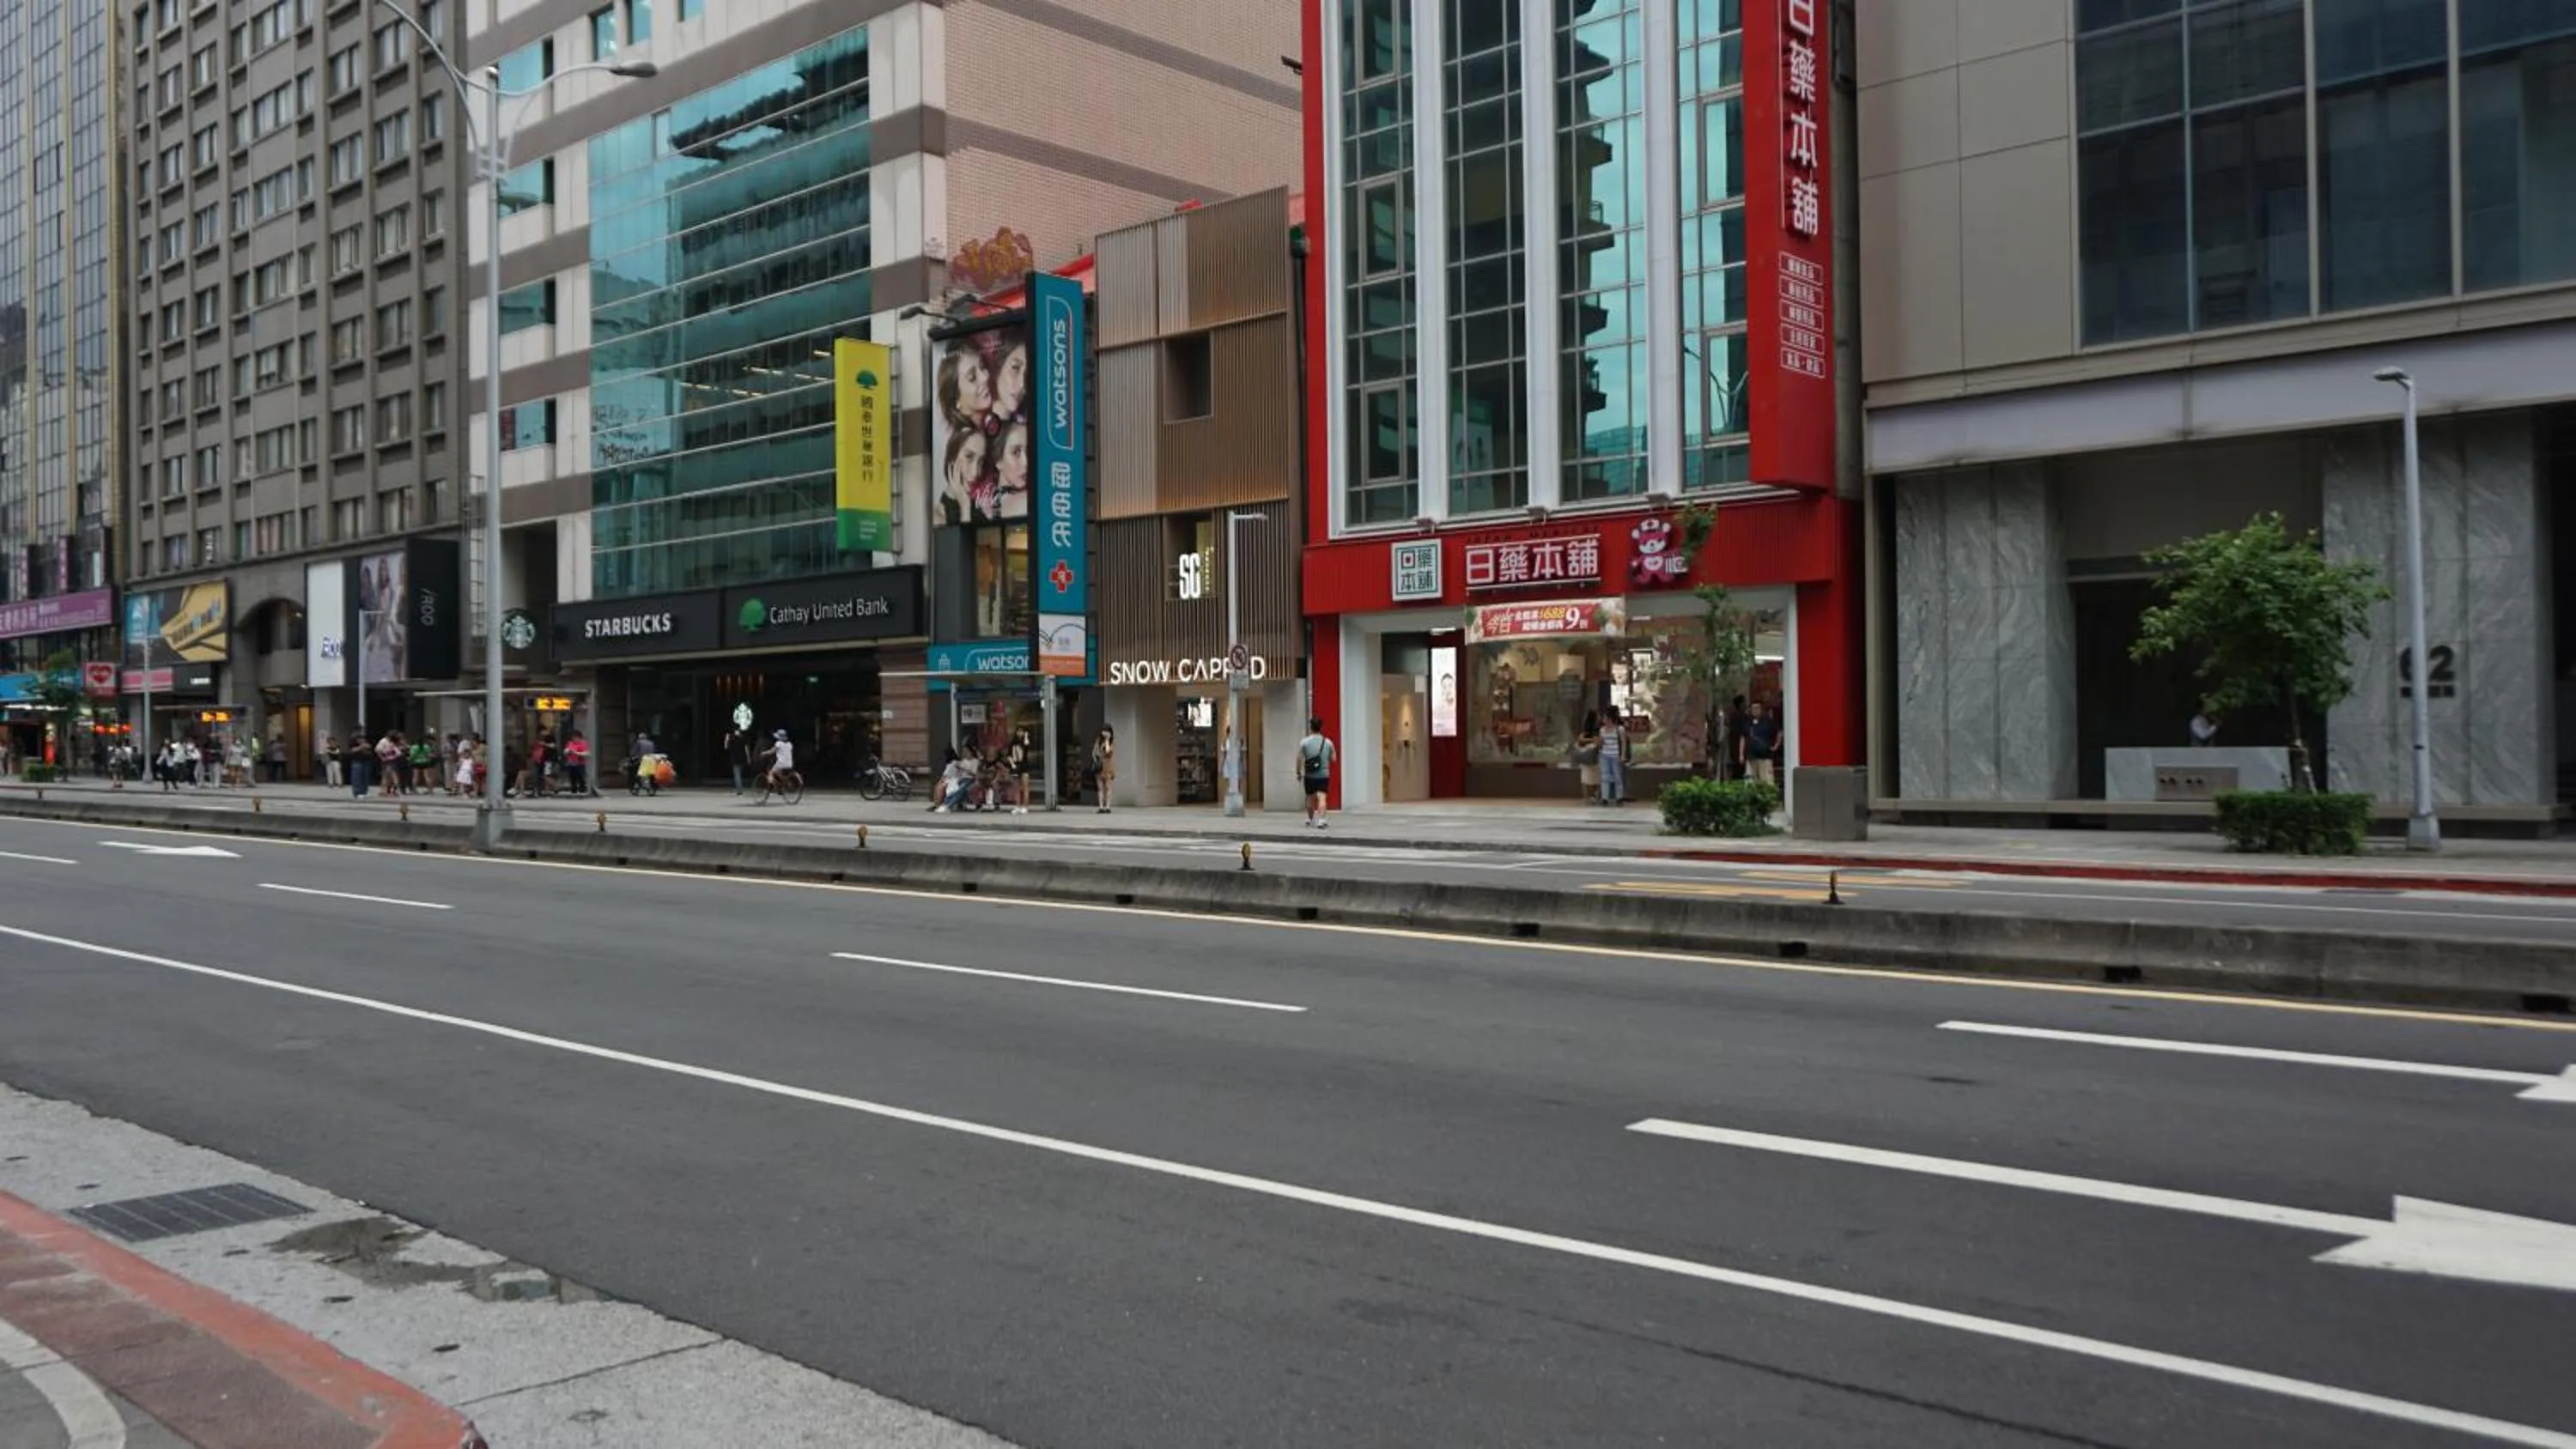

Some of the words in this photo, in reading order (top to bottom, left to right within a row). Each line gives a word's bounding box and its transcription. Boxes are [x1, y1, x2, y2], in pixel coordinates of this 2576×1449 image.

[1053, 318, 1068, 429] watsons
[1050, 461, 1072, 549] 屈臣氏
[769, 606, 810, 625] Cathay
[813, 598, 854, 621] United
[856, 596, 889, 616] Bank
[585, 612, 671, 639] STARBUCKS
[1110, 660, 1171, 685] SNOW
[1178, 656, 1266, 682] CAPPD
